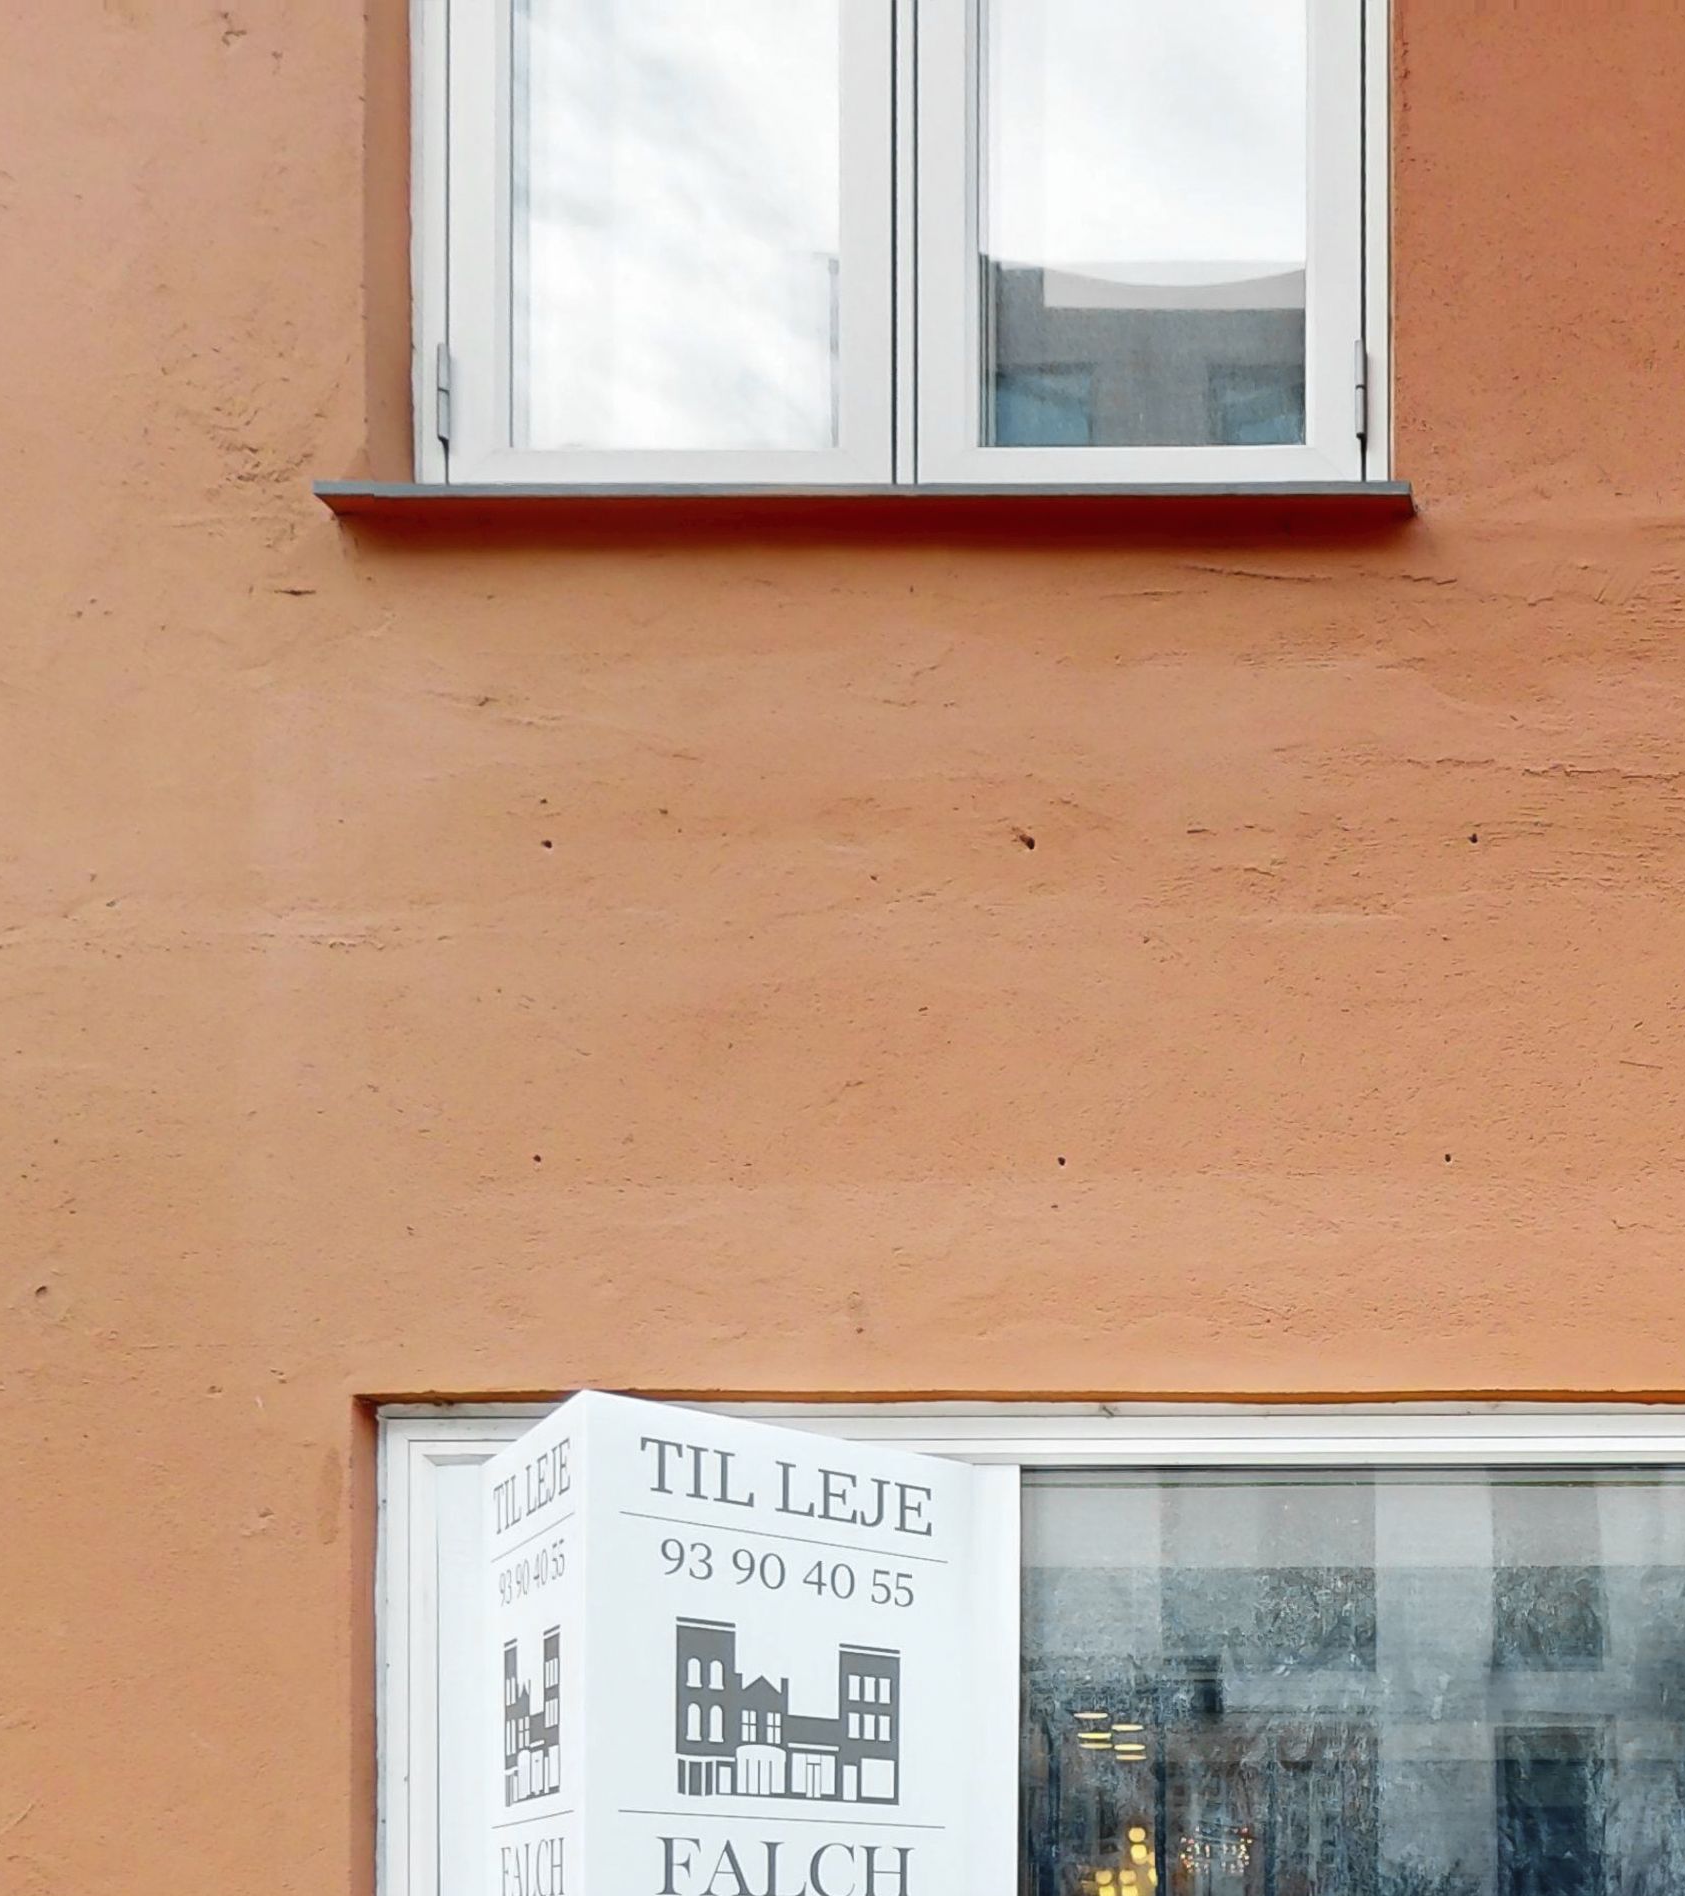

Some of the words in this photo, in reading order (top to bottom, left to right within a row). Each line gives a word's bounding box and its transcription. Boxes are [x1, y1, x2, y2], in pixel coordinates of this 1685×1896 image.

[493, 1474, 521, 1535] TIL
[525, 1437, 570, 1516] LEJE
[640, 1436, 754, 1507] TIL
[775, 1460, 932, 1537] LEJE
[499, 1569, 512, 1607] 93
[516, 1558, 530, 1598] 90
[533, 1549, 548, 1588] 40
[660, 1538, 713, 1580] 93
[732, 1549, 786, 1590] 90
[802, 1560, 855, 1599] 40
[871, 1569, 915, 1607] 55
